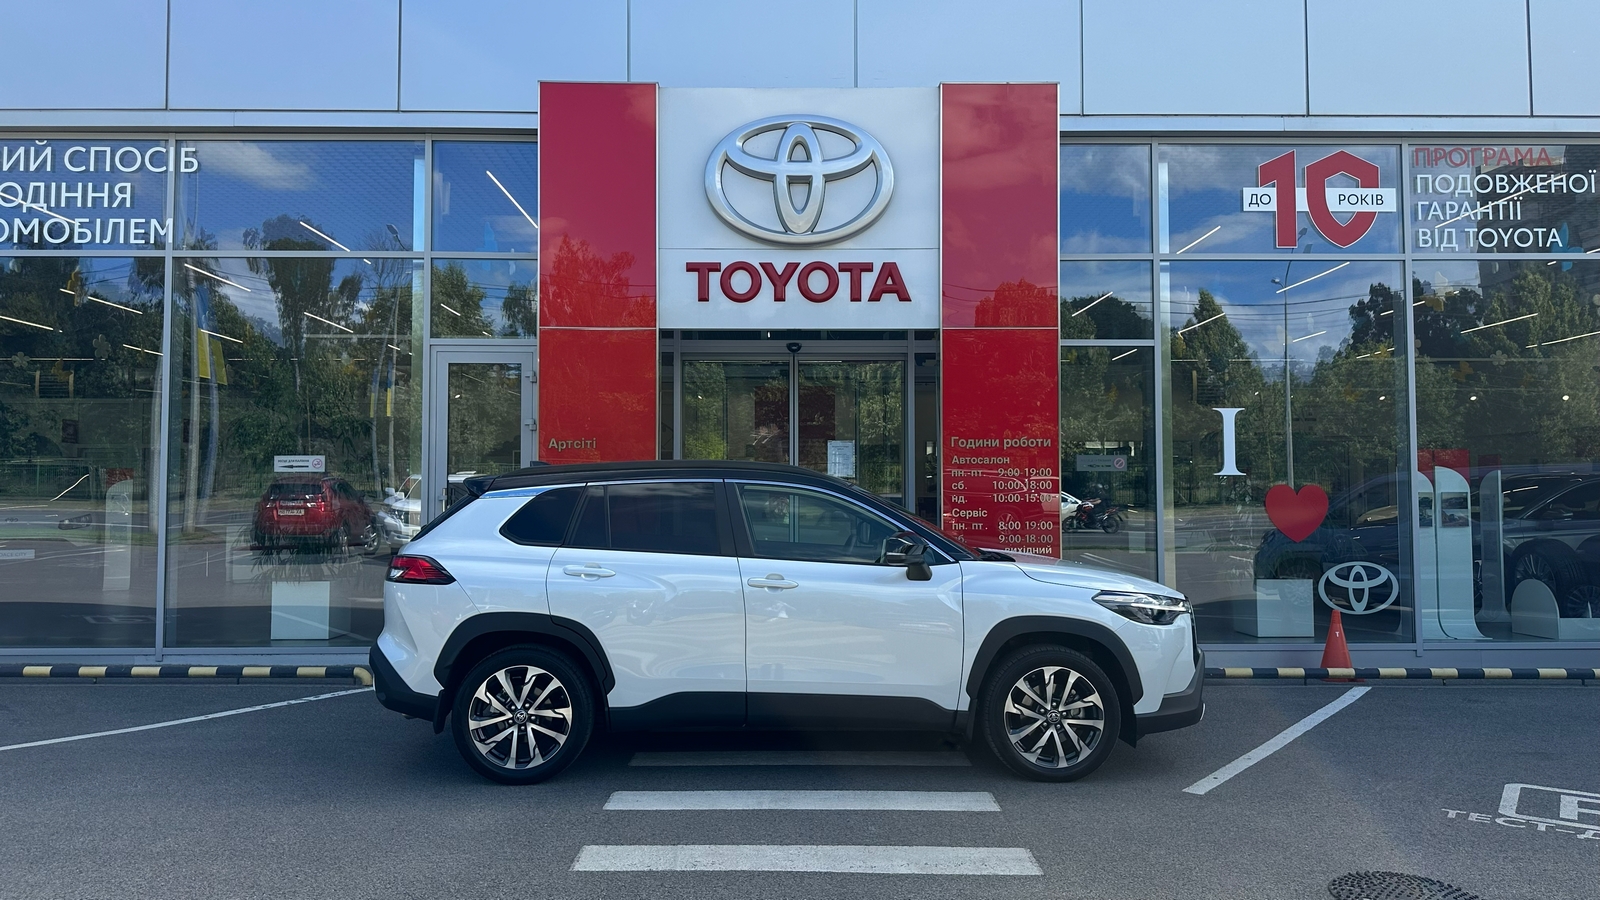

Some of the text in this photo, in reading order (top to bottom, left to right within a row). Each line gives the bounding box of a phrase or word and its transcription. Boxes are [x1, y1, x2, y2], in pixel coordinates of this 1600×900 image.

[3, 140, 199, 173] ИЙ СПОСІБ
[1414, 147, 1552, 167] ПРОГРАМА
[1417, 169, 1597, 196] ПОДОВЖЕНОЇ
[0, 182, 131, 213] ОДІННЯ
[1248, 194, 1271, 207] ДО
[1338, 194, 1384, 206] РОКІВ
[1417, 197, 1522, 221] ГАРАНТІЇ
[1418, 228, 1563, 252] ВІД TOYOTA
[686, 261, 912, 303] TOYOTA
[548, 437, 597, 453] Артсіті
[951, 436, 1051, 450] Години роботи
[1213, 407, 1247, 477] I
[952, 455, 1010, 465] Автосалон
[997, 467, 1053, 477] 9:00-19:00
[951, 480, 1053, 490] сб. 10:00-18:00
[951, 494, 1053, 503] нд. 10:00-15:00
[952, 508, 988, 519] Сервіс
[952, 522, 968, 530] пн.
[1025, 521, 1053, 530] 19:00
